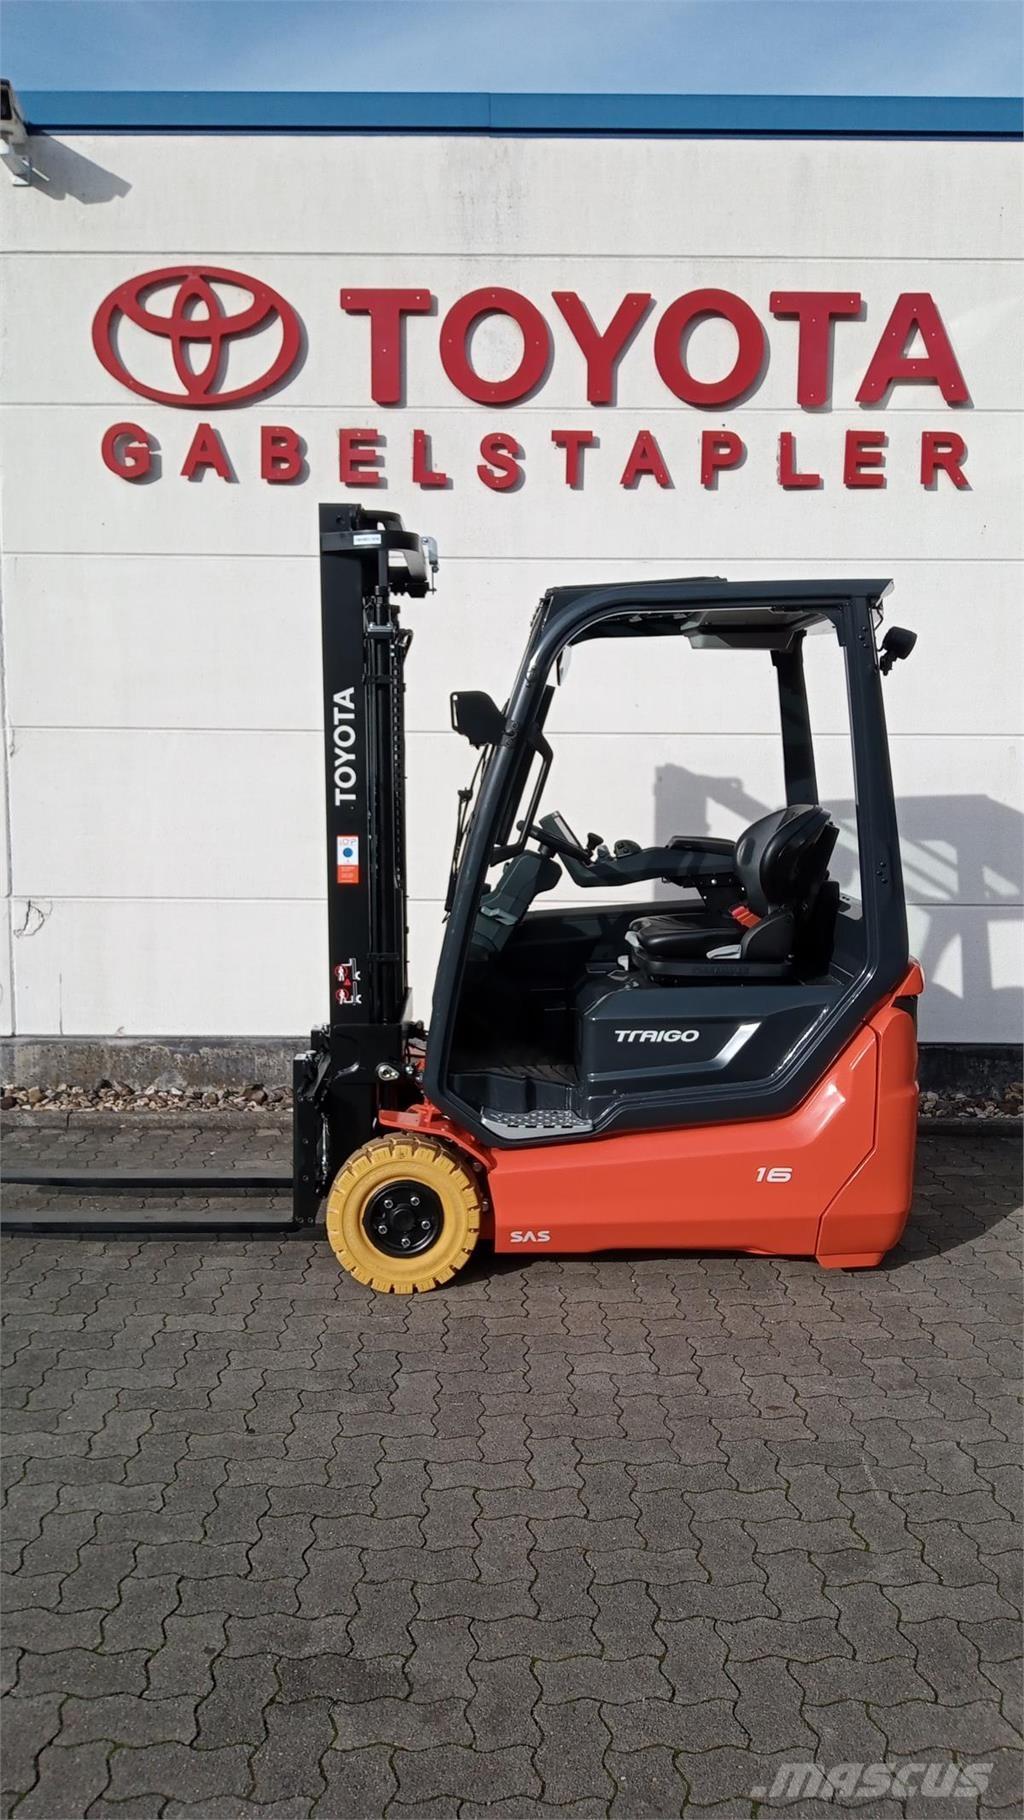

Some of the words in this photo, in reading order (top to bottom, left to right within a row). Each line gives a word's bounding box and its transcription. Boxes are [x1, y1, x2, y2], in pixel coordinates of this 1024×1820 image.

[340, 287, 970, 406] TOYOTA
[101, 422, 969, 490] GABELSTAPLER
[333, 687, 357, 806] TOYOTA
[756, 1167, 793, 1183] 16
[510, 1230, 551, 1243] SAS
